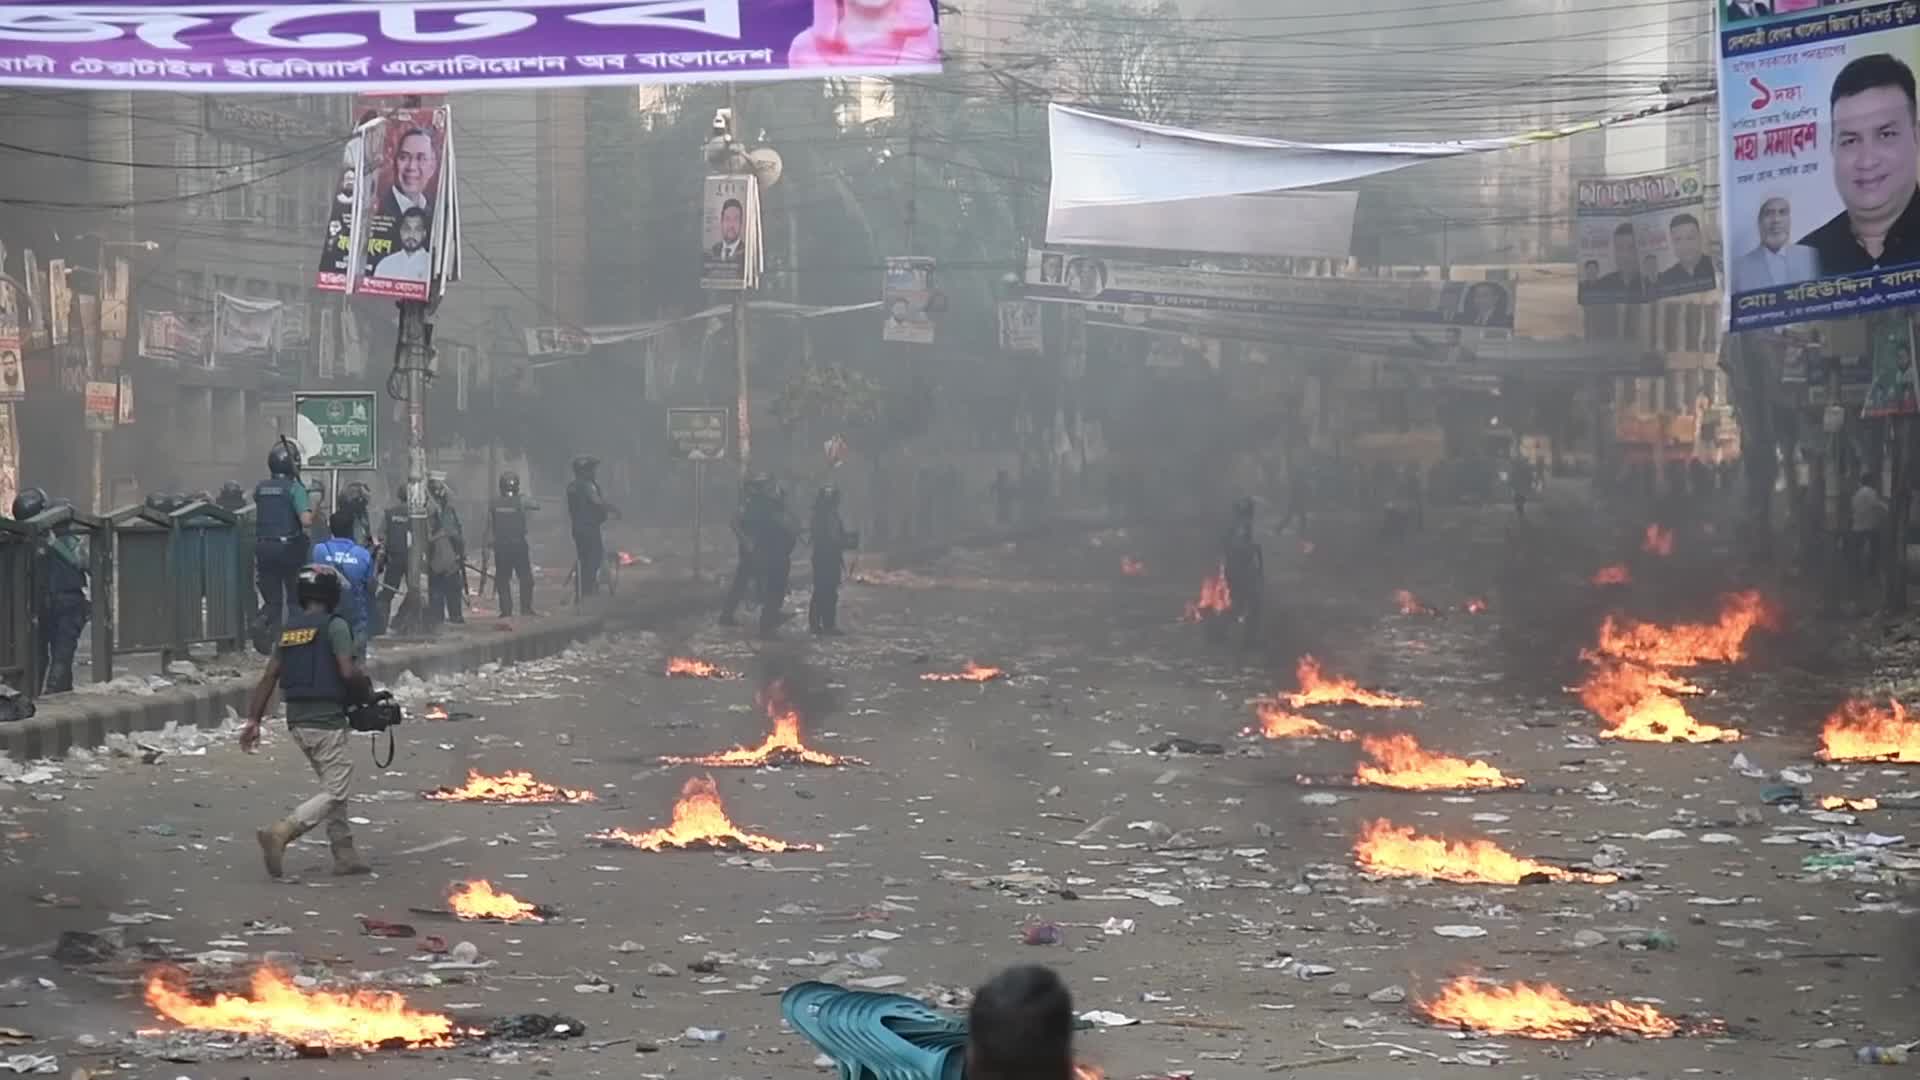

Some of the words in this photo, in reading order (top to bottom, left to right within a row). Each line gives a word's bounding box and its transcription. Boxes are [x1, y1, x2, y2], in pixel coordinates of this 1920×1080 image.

[382, 54, 568, 76] এসোসিয়েশন
[576, 53, 627, 71] অব
[634, 47, 772, 69] বাংলাদেশ
[1750, 77, 1771, 110] ১
[1733, 132, 1758, 160] মহা
[1763, 122, 1817, 158] সমাবেশ
[1739, 292, 1777, 310] মোঃ
[1784, 276, 1873, 302] মহিউদ্দিন
[281, 629, 318, 643] PRESS
